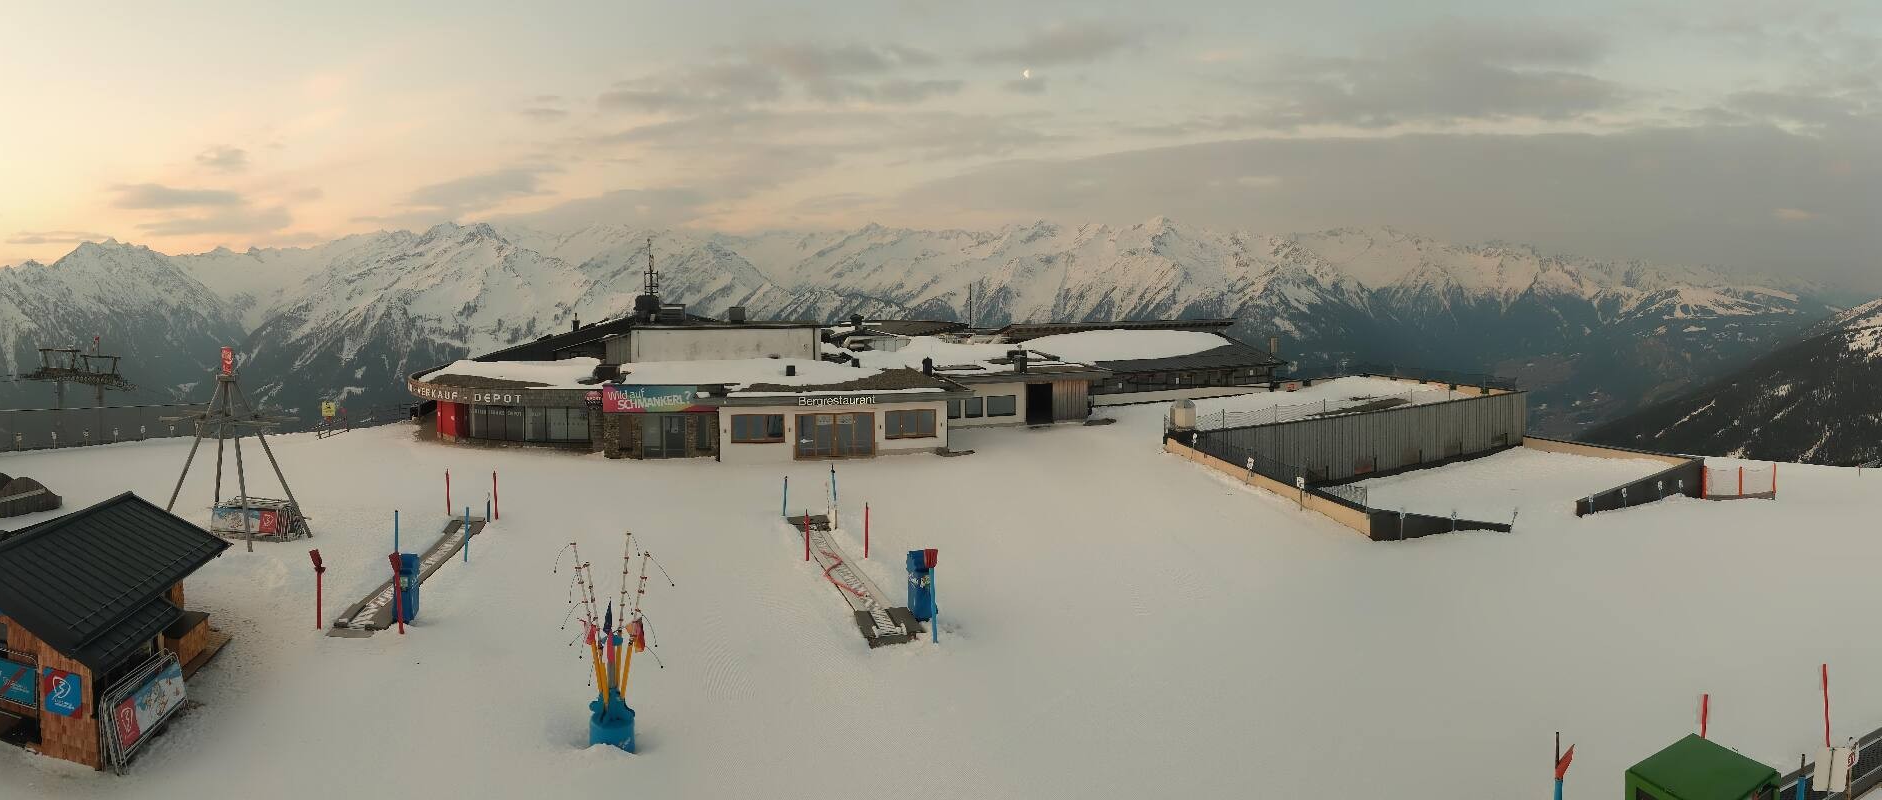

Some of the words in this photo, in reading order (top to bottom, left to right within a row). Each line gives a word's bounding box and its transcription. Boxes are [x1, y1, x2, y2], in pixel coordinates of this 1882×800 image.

[417, 387, 458, 400] VERKAUF
[474, 393, 522, 404] DEPOT
[607, 389, 628, 401] Wild
[629, 387, 645, 399] auf
[617, 390, 692, 410] SCHMANKERL?
[798, 394, 876, 407] Bergrestaurant
